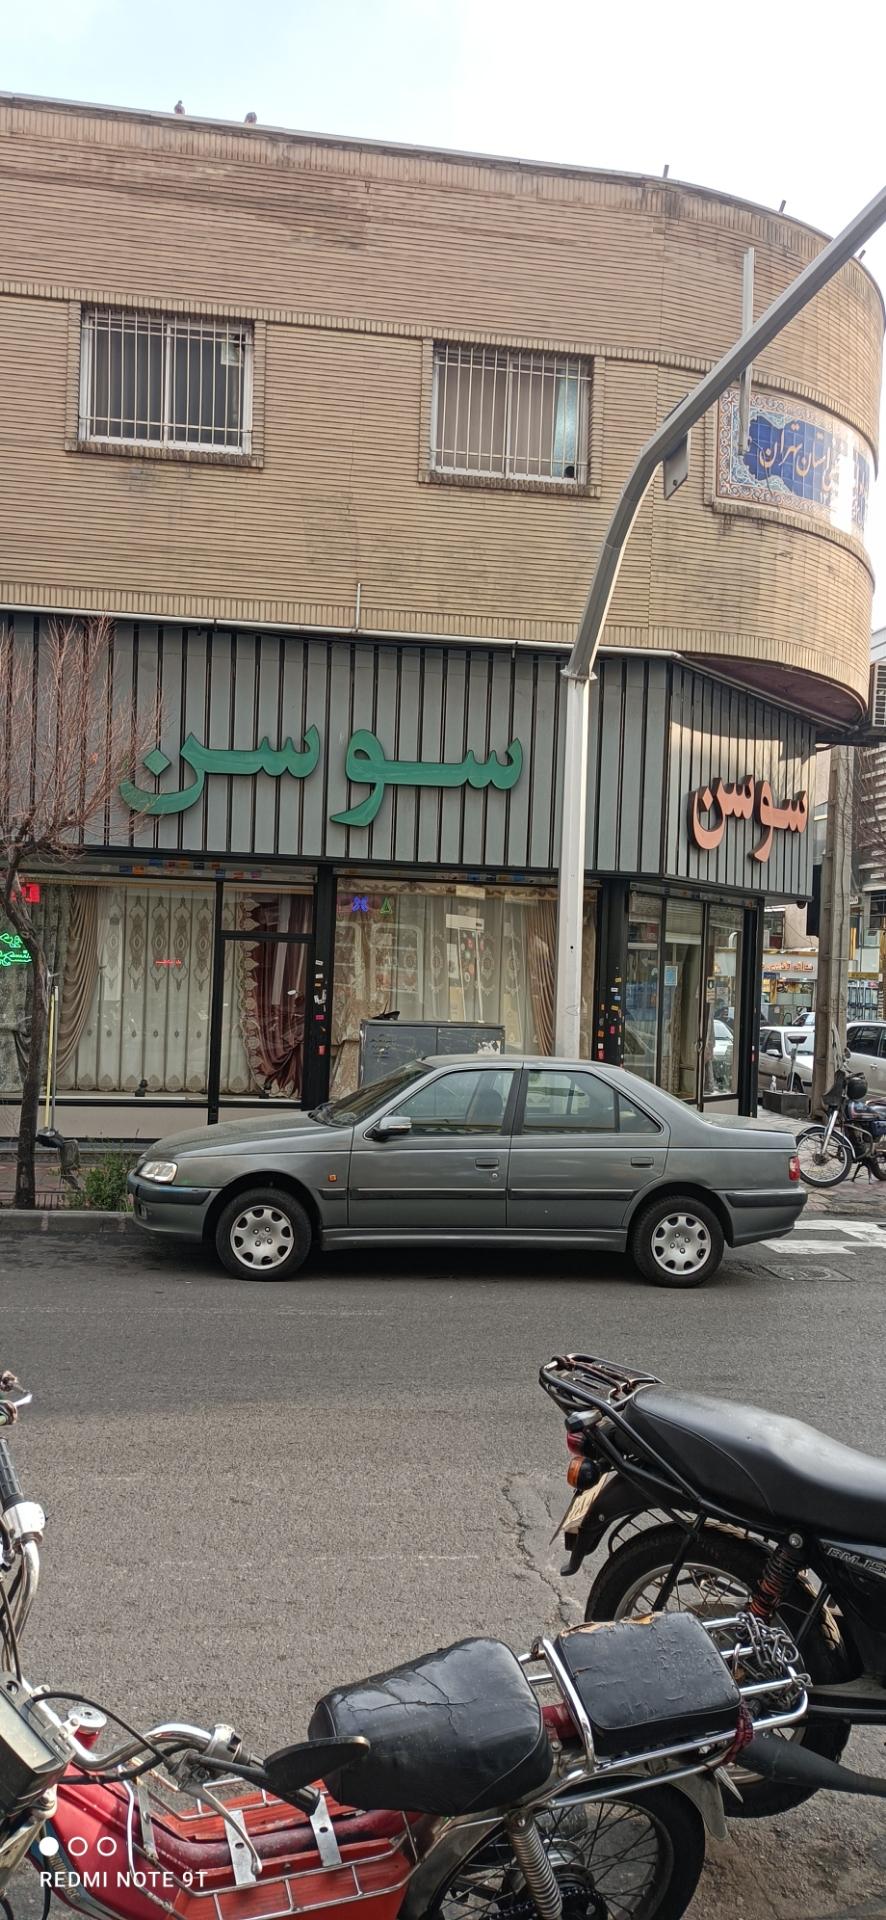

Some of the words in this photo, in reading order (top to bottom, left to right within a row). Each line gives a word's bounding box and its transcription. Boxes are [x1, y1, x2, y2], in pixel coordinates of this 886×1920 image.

[759, 423, 803, 468] تهران
[119, 724, 523, 827] سوسن
[689, 775, 808, 863] سوسن
